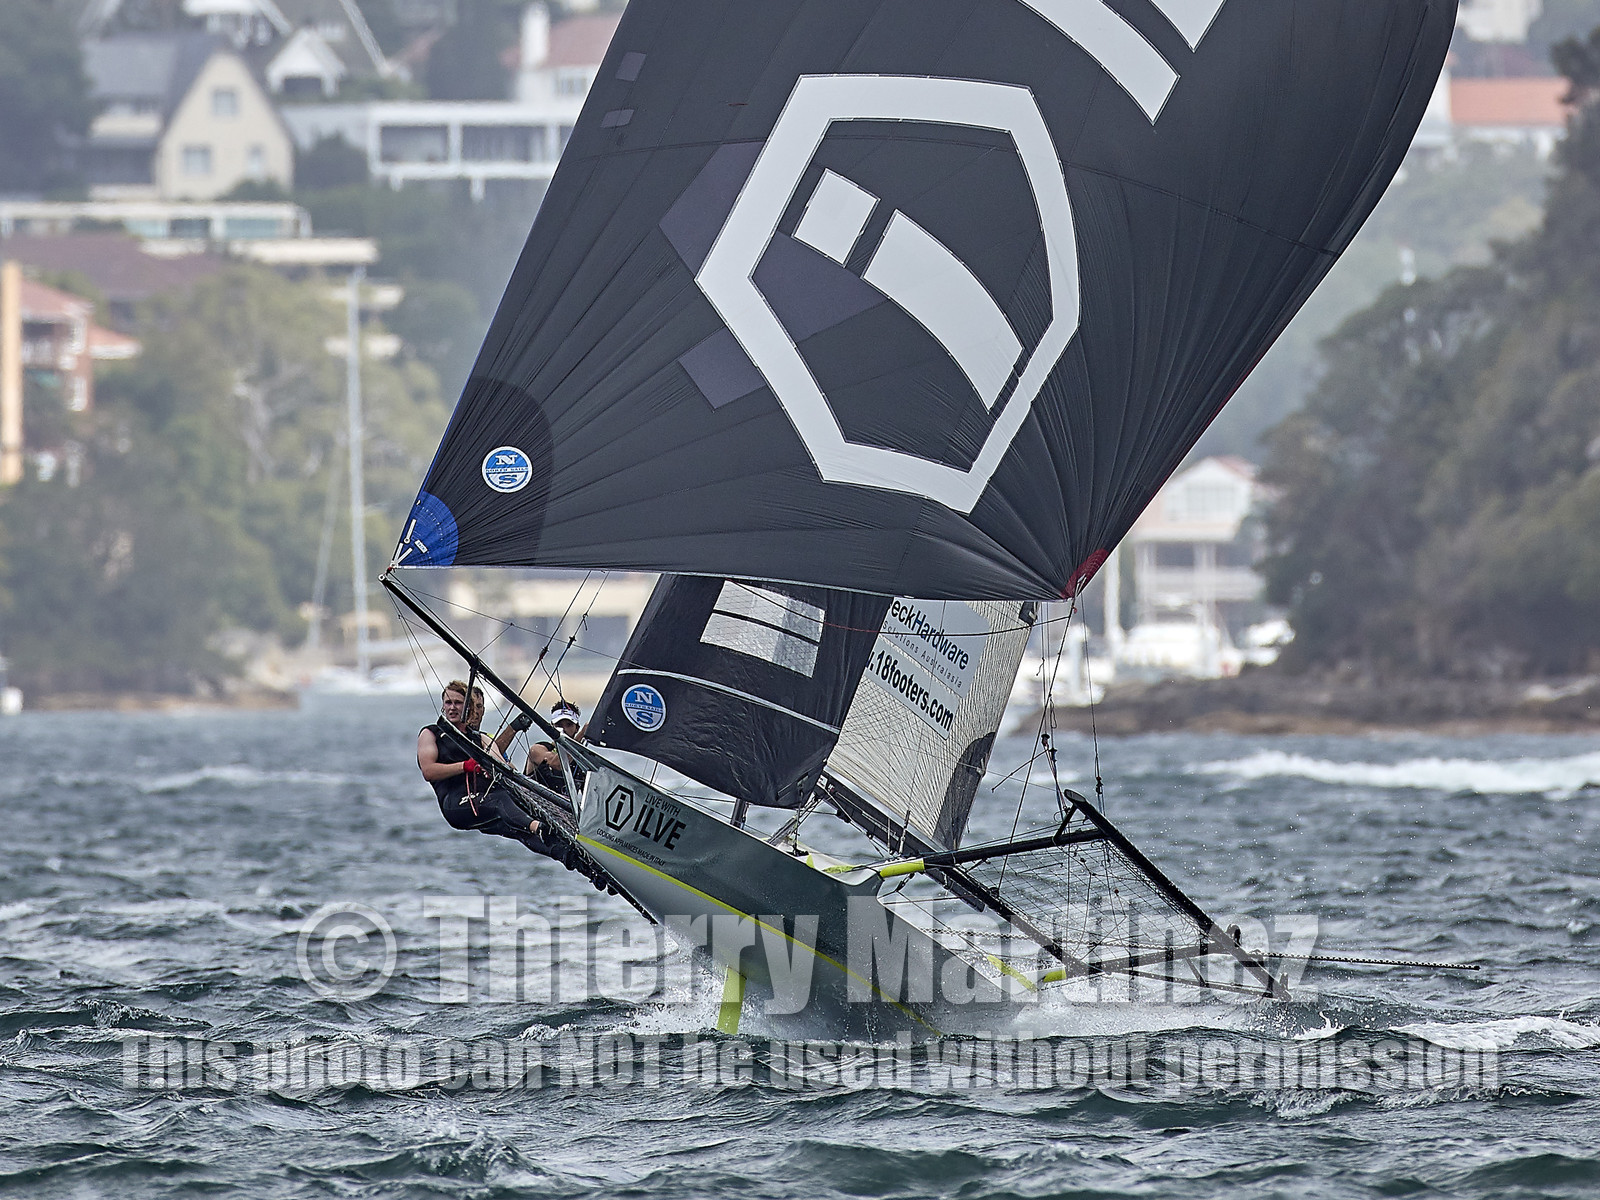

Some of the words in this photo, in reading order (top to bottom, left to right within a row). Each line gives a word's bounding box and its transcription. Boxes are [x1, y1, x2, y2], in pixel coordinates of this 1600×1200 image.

[920, 650, 963, 689] Australasia
[634, 690, 655, 705] N
[636, 710, 654, 725] S
[645, 793, 662, 809] LIVE
[660, 800, 681, 817] WITH
[632, 803, 687, 851] ILVE
